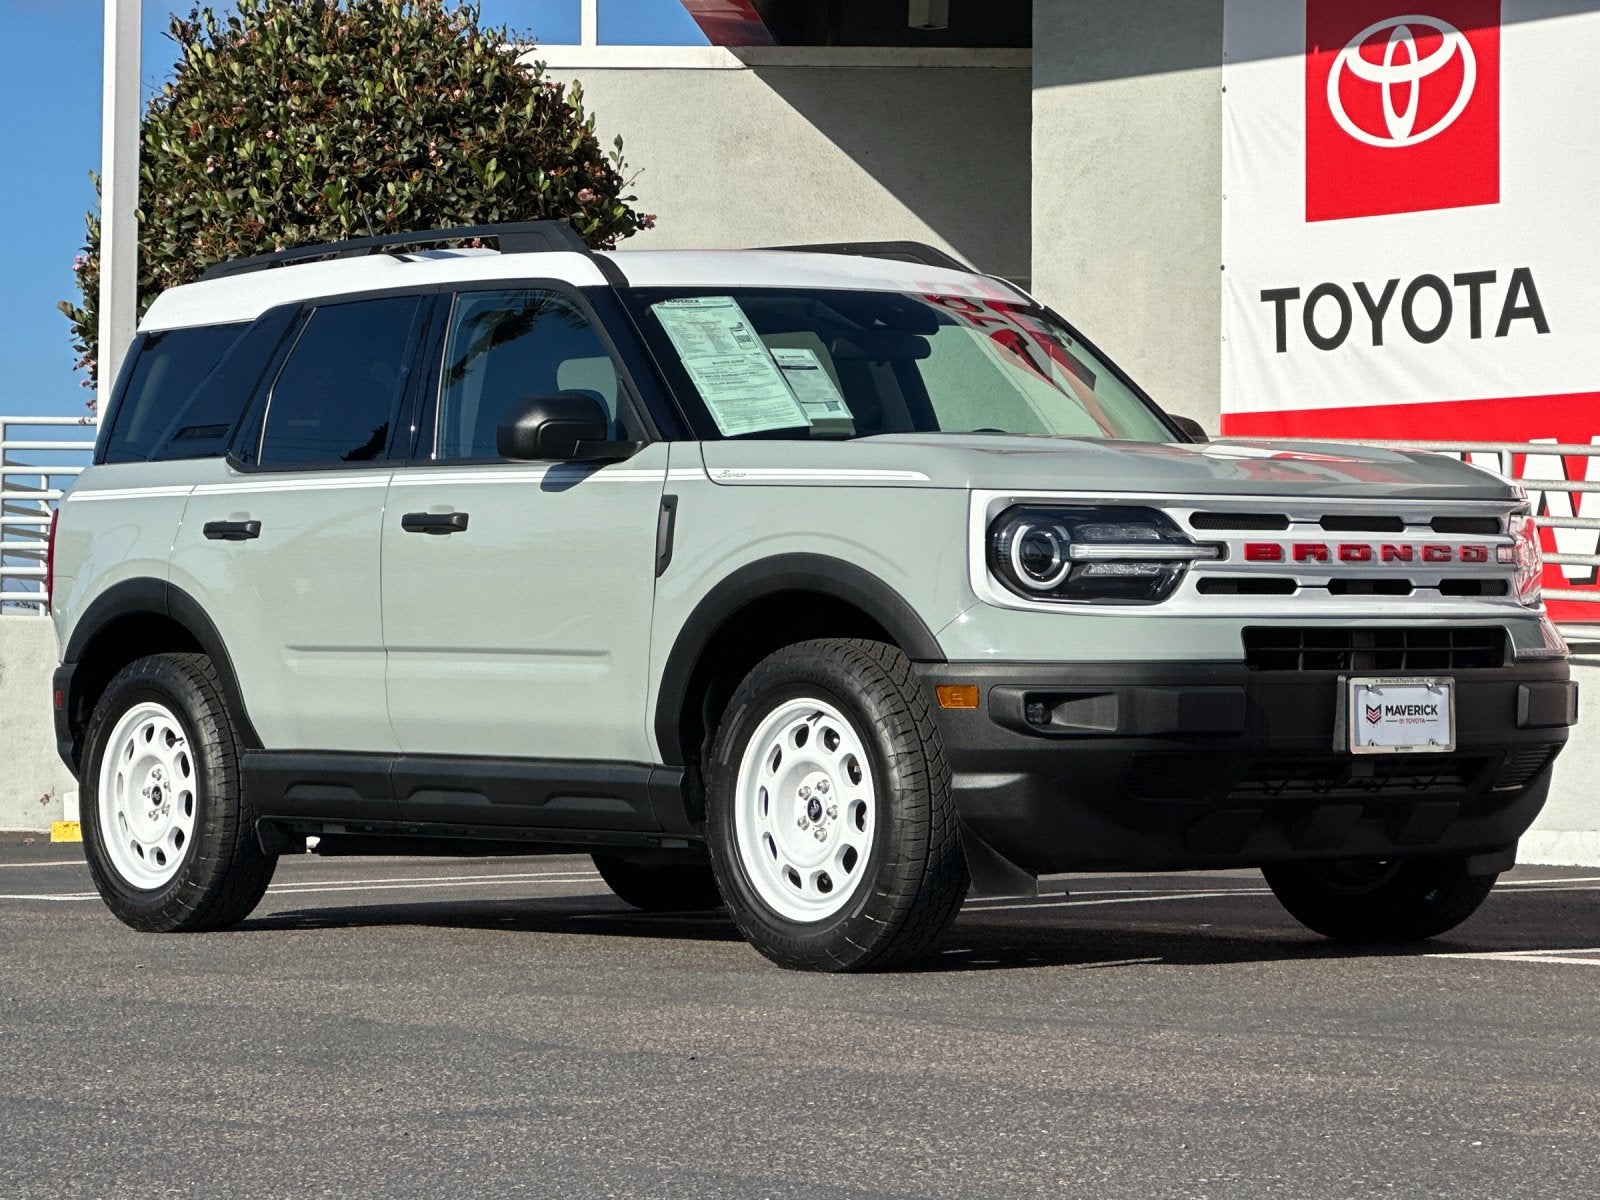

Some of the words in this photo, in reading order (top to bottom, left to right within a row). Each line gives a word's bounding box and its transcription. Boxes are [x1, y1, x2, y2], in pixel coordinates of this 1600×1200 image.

[1260, 267, 1550, 353] TOYOTA
[1243, 542, 1489, 563] BRONCO
[1386, 704, 1438, 716] MAVERICK
